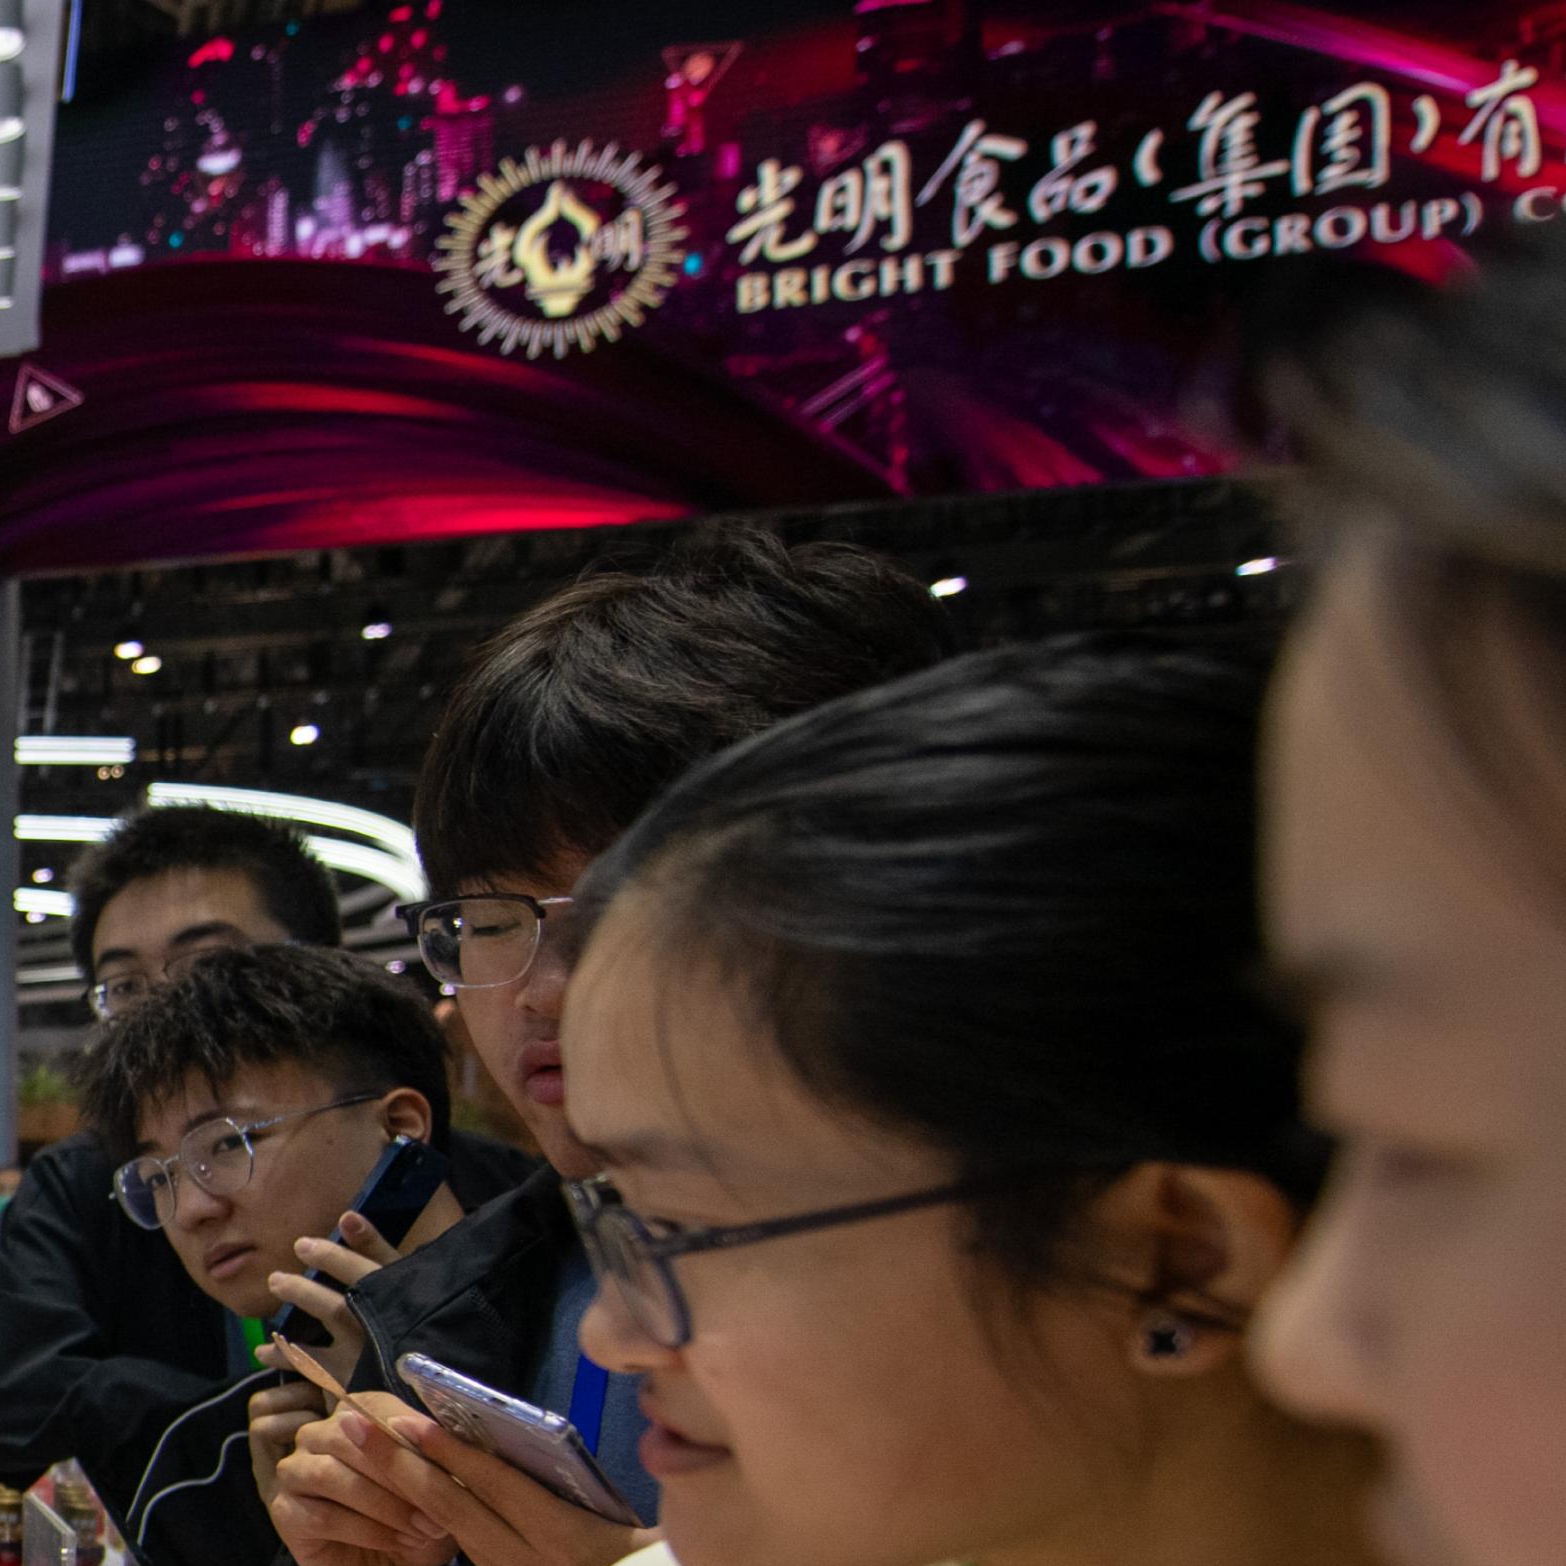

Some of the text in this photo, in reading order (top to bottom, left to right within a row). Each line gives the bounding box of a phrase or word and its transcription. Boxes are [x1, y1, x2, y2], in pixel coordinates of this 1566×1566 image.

[736, 249, 967, 314] BRIGHT
[988, 224, 1174, 284] FOOD
[1199, 192, 1484, 263] (GROUP)
